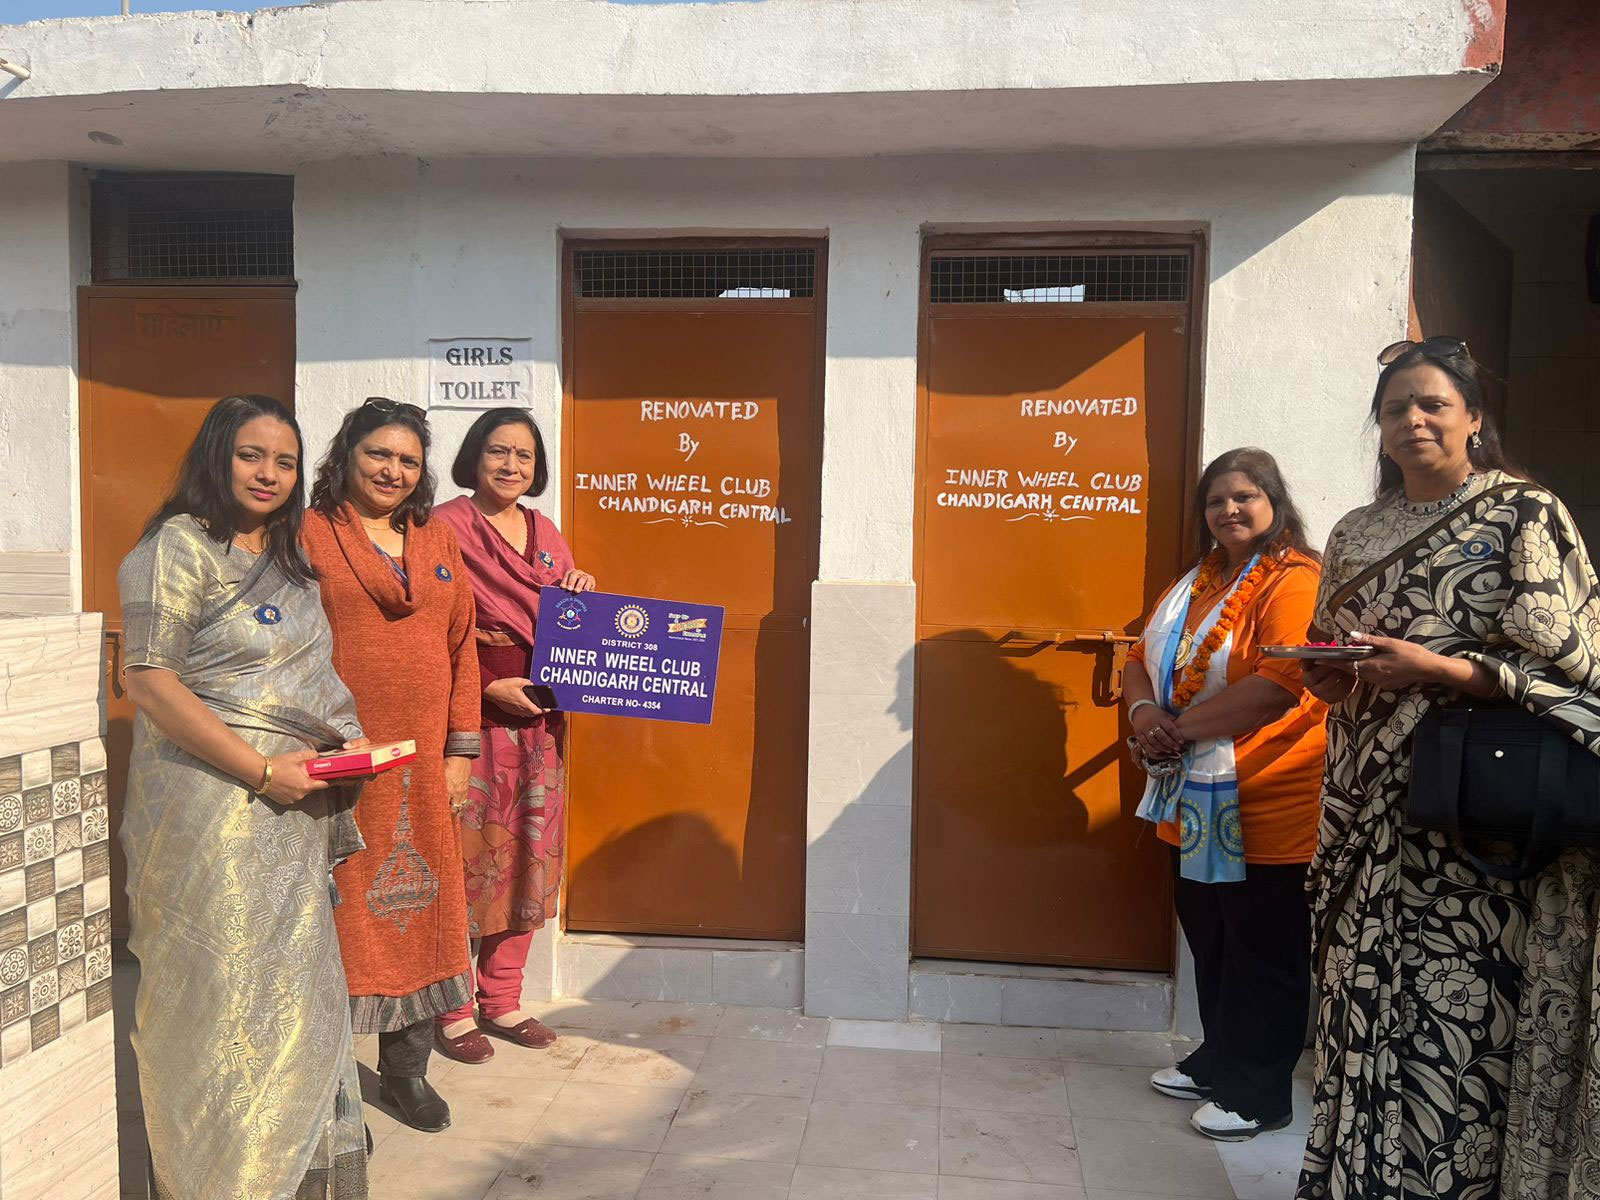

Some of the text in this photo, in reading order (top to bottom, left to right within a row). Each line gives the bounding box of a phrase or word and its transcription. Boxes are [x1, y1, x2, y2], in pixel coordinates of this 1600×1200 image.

[445, 347, 514, 367] GIRLS
[439, 381, 521, 400] TOILET
[640, 400, 759, 422] RENOVATED
[1020, 397, 1138, 417] RENOVATED
[676, 432, 700, 462] By
[1053, 431, 1078, 456] By
[575, 472, 771, 498] INNER WHEEL CLUB
[944, 468, 1143, 492] INNER WHEEL CLUB
[598, 495, 792, 524] CHANDIGARH CENTRAL
[936, 492, 1142, 514] CHANDIGARH CENTRAL
[601, 638, 658, 651] DISTRICT 308
[550, 646, 701, 677] INNER WHEEL CLUB
[540, 665, 708, 698] CHANDIGARH CENTRAL
[581, 694, 624, 707] CHARTER
[642, 700, 661, 710] 4354
